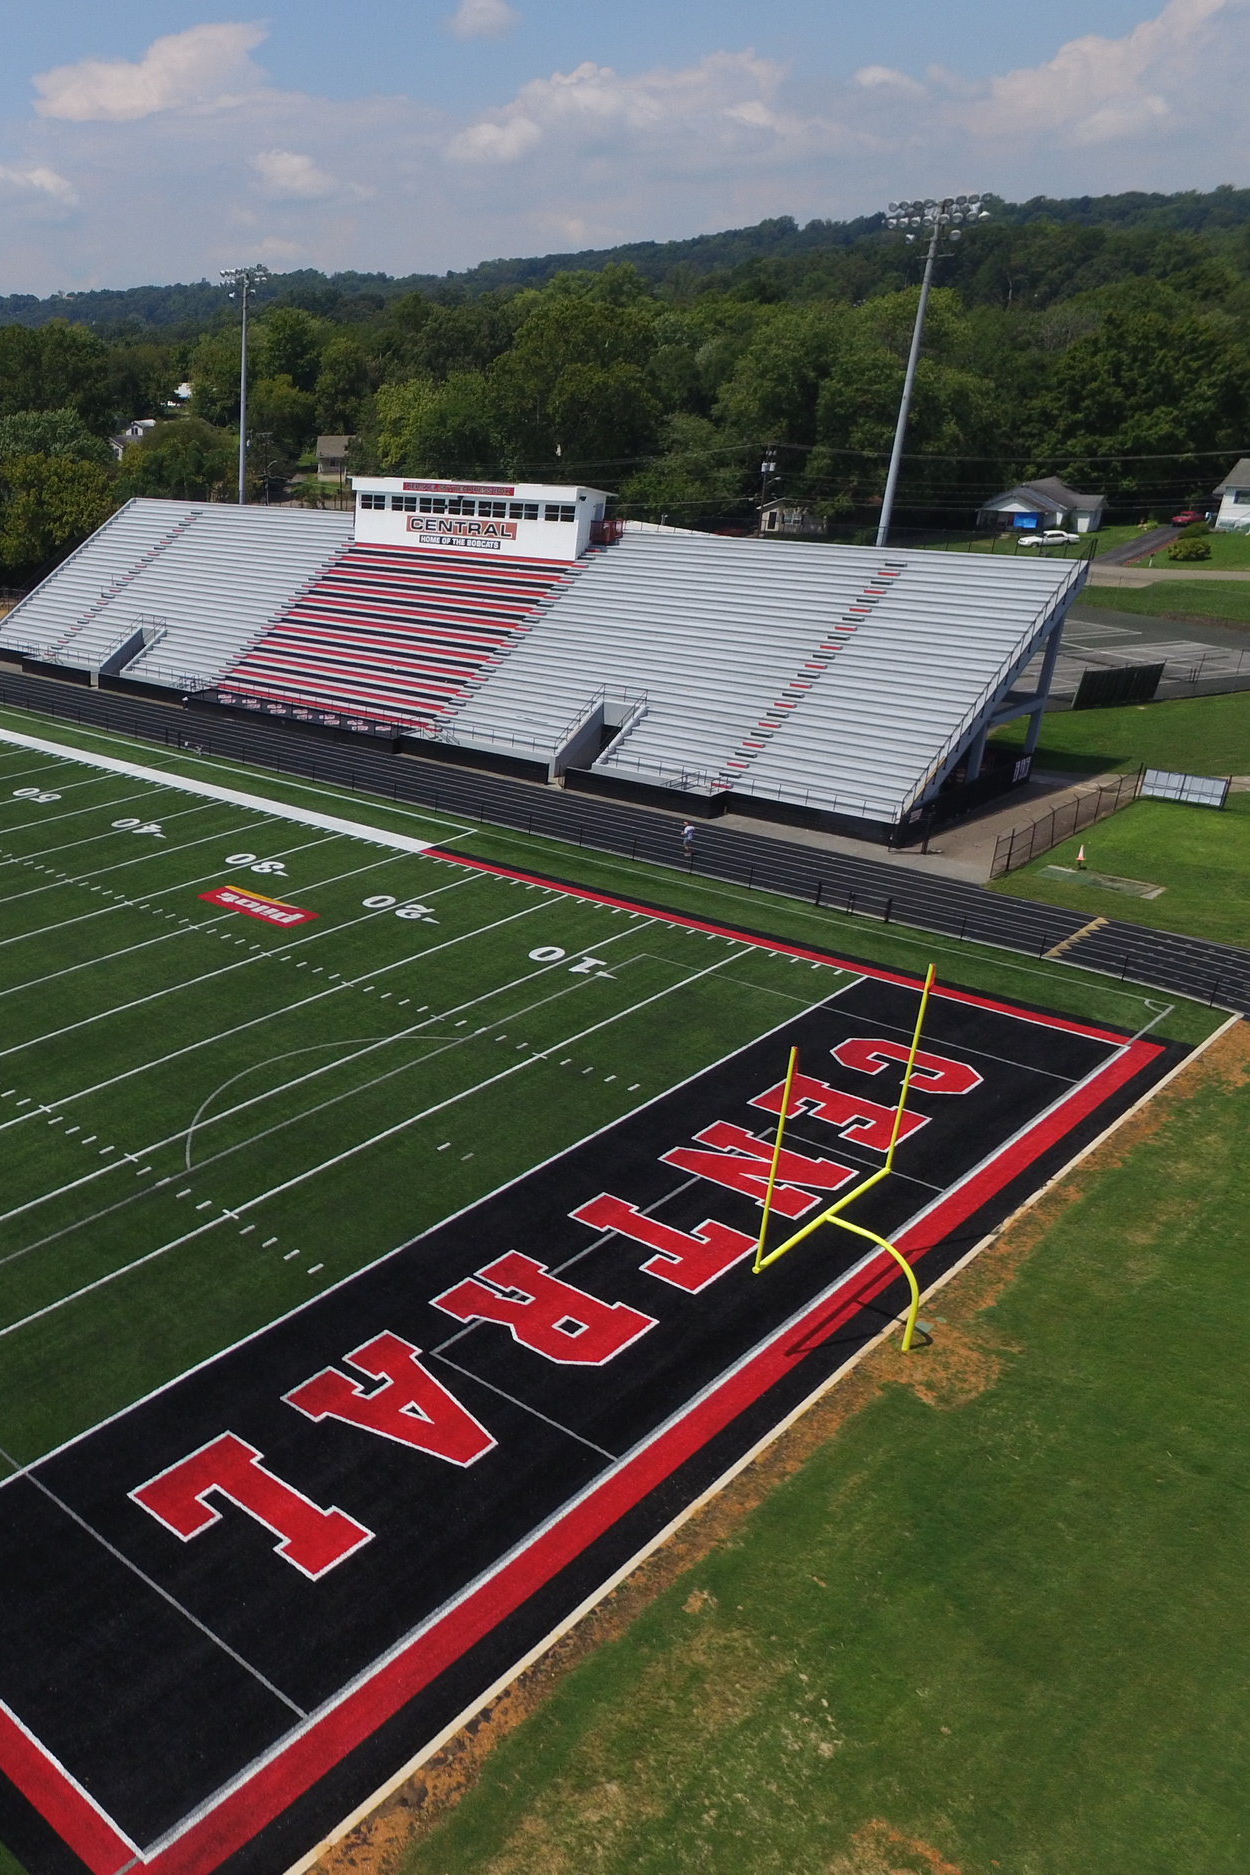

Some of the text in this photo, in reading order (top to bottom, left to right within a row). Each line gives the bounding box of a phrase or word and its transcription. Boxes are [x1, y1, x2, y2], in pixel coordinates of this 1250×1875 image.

[409, 517, 513, 538] CENTRAL
[420, 535, 440, 544] HOME
[452, 538, 465, 546] THE
[466, 540, 499, 549] BOBCATS
[12, 787, 62, 804] 50
[110, 818, 162, 837] 40
[225, 853, 286, 875] 30
[215, 891, 306, 924] pilot
[362, 894, 437, 921] 20
[528, 946, 607, 974] 10
[127, 1037, 984, 1581] CENTRAL
